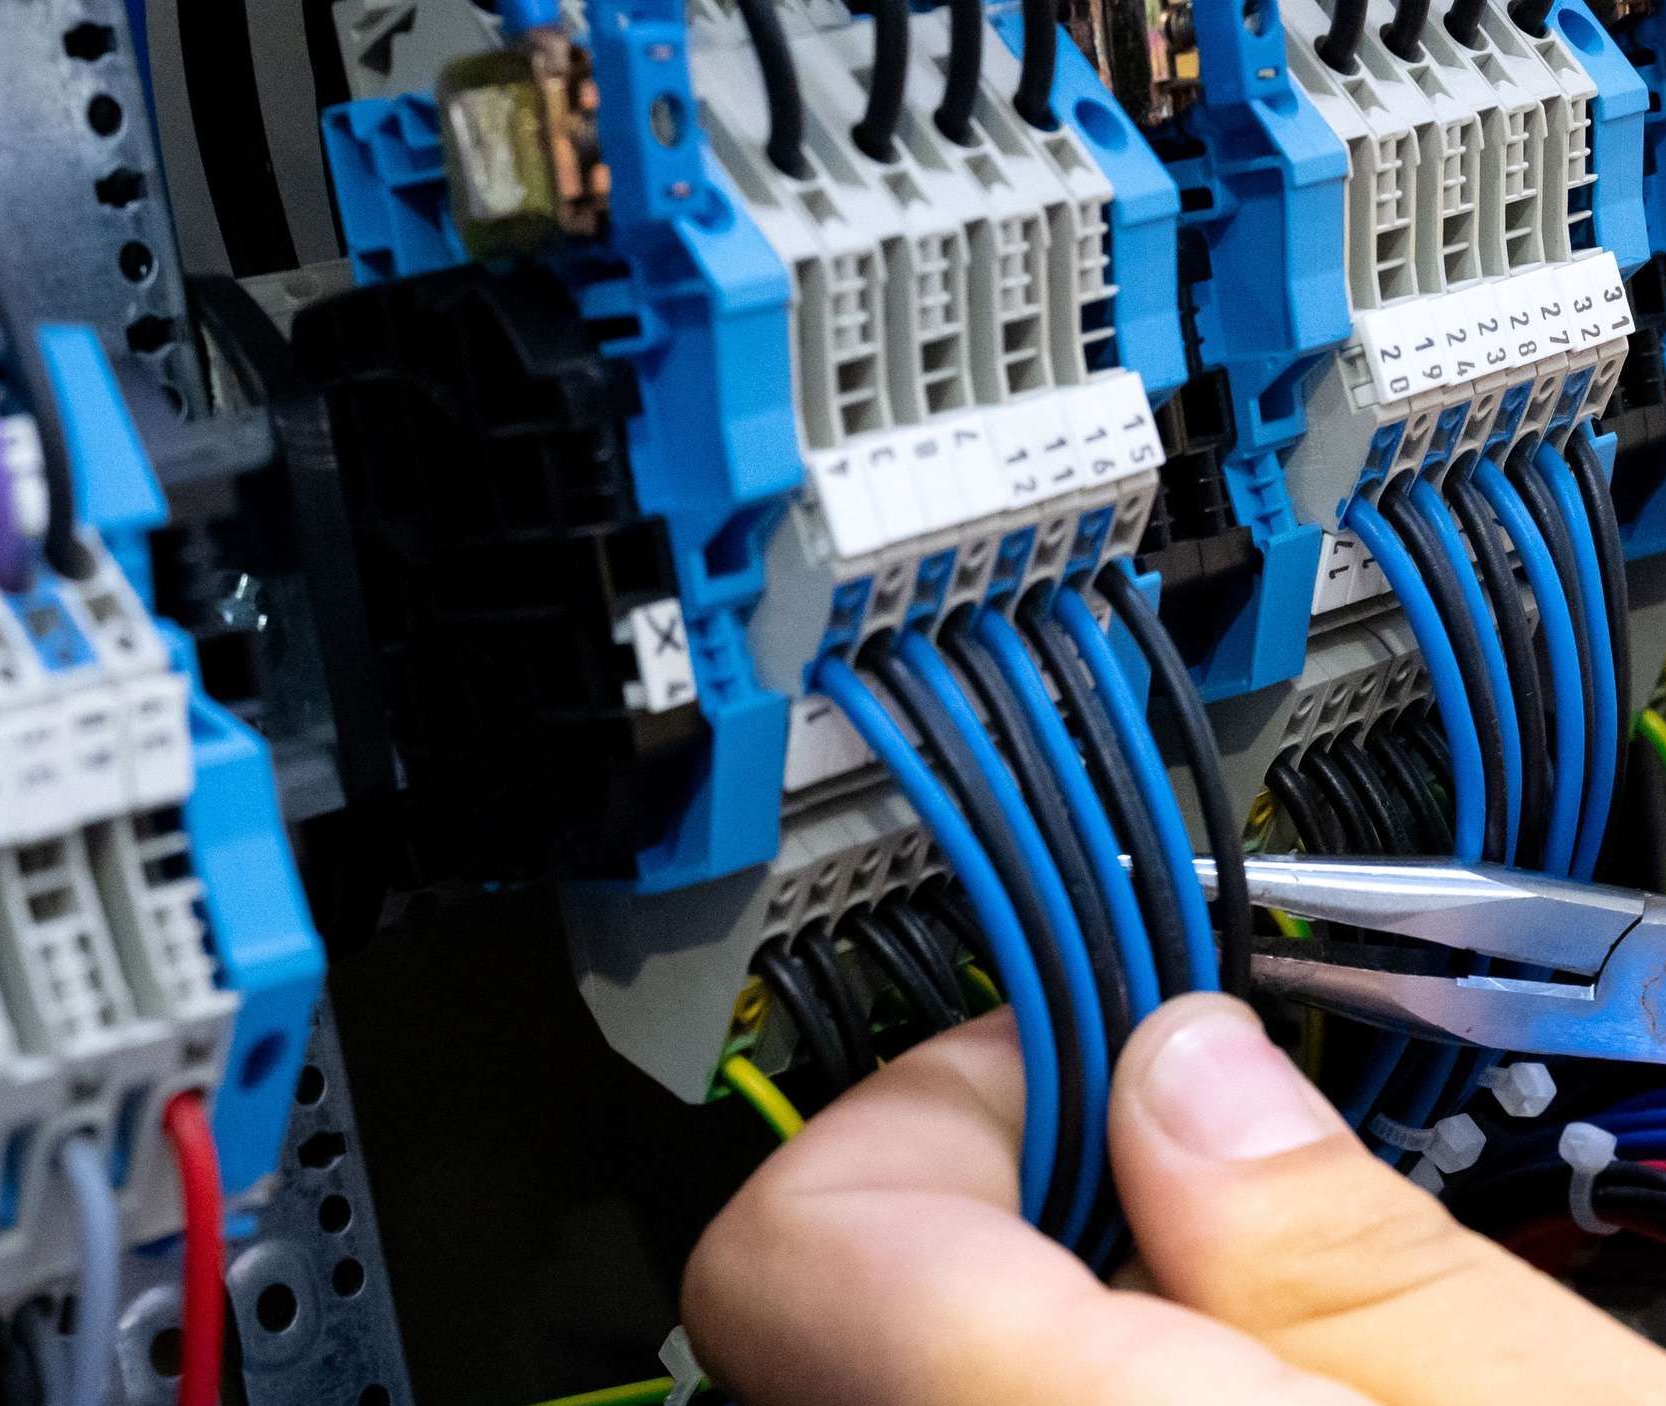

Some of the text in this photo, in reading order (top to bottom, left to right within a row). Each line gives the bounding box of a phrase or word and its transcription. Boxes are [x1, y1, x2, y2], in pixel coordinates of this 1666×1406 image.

[1540, 301, 1571, 347] 27
[1573, 295, 1601, 342] 32
[1603, 285, 1630, 331] 31
[1415, 336, 1443, 380] 19
[1446, 328, 1476, 377] 24
[1478, 318, 1506, 365] 23
[1509, 311, 1538, 358] 28
[1381, 345, 1410, 394] 20
[1044, 436, 1075, 483] 11
[1084, 426, 1115, 475] 16
[1124, 413, 1155, 464] 15
[1006, 449, 1037, 495] 12
[1328, 540, 1355, 580] 17
